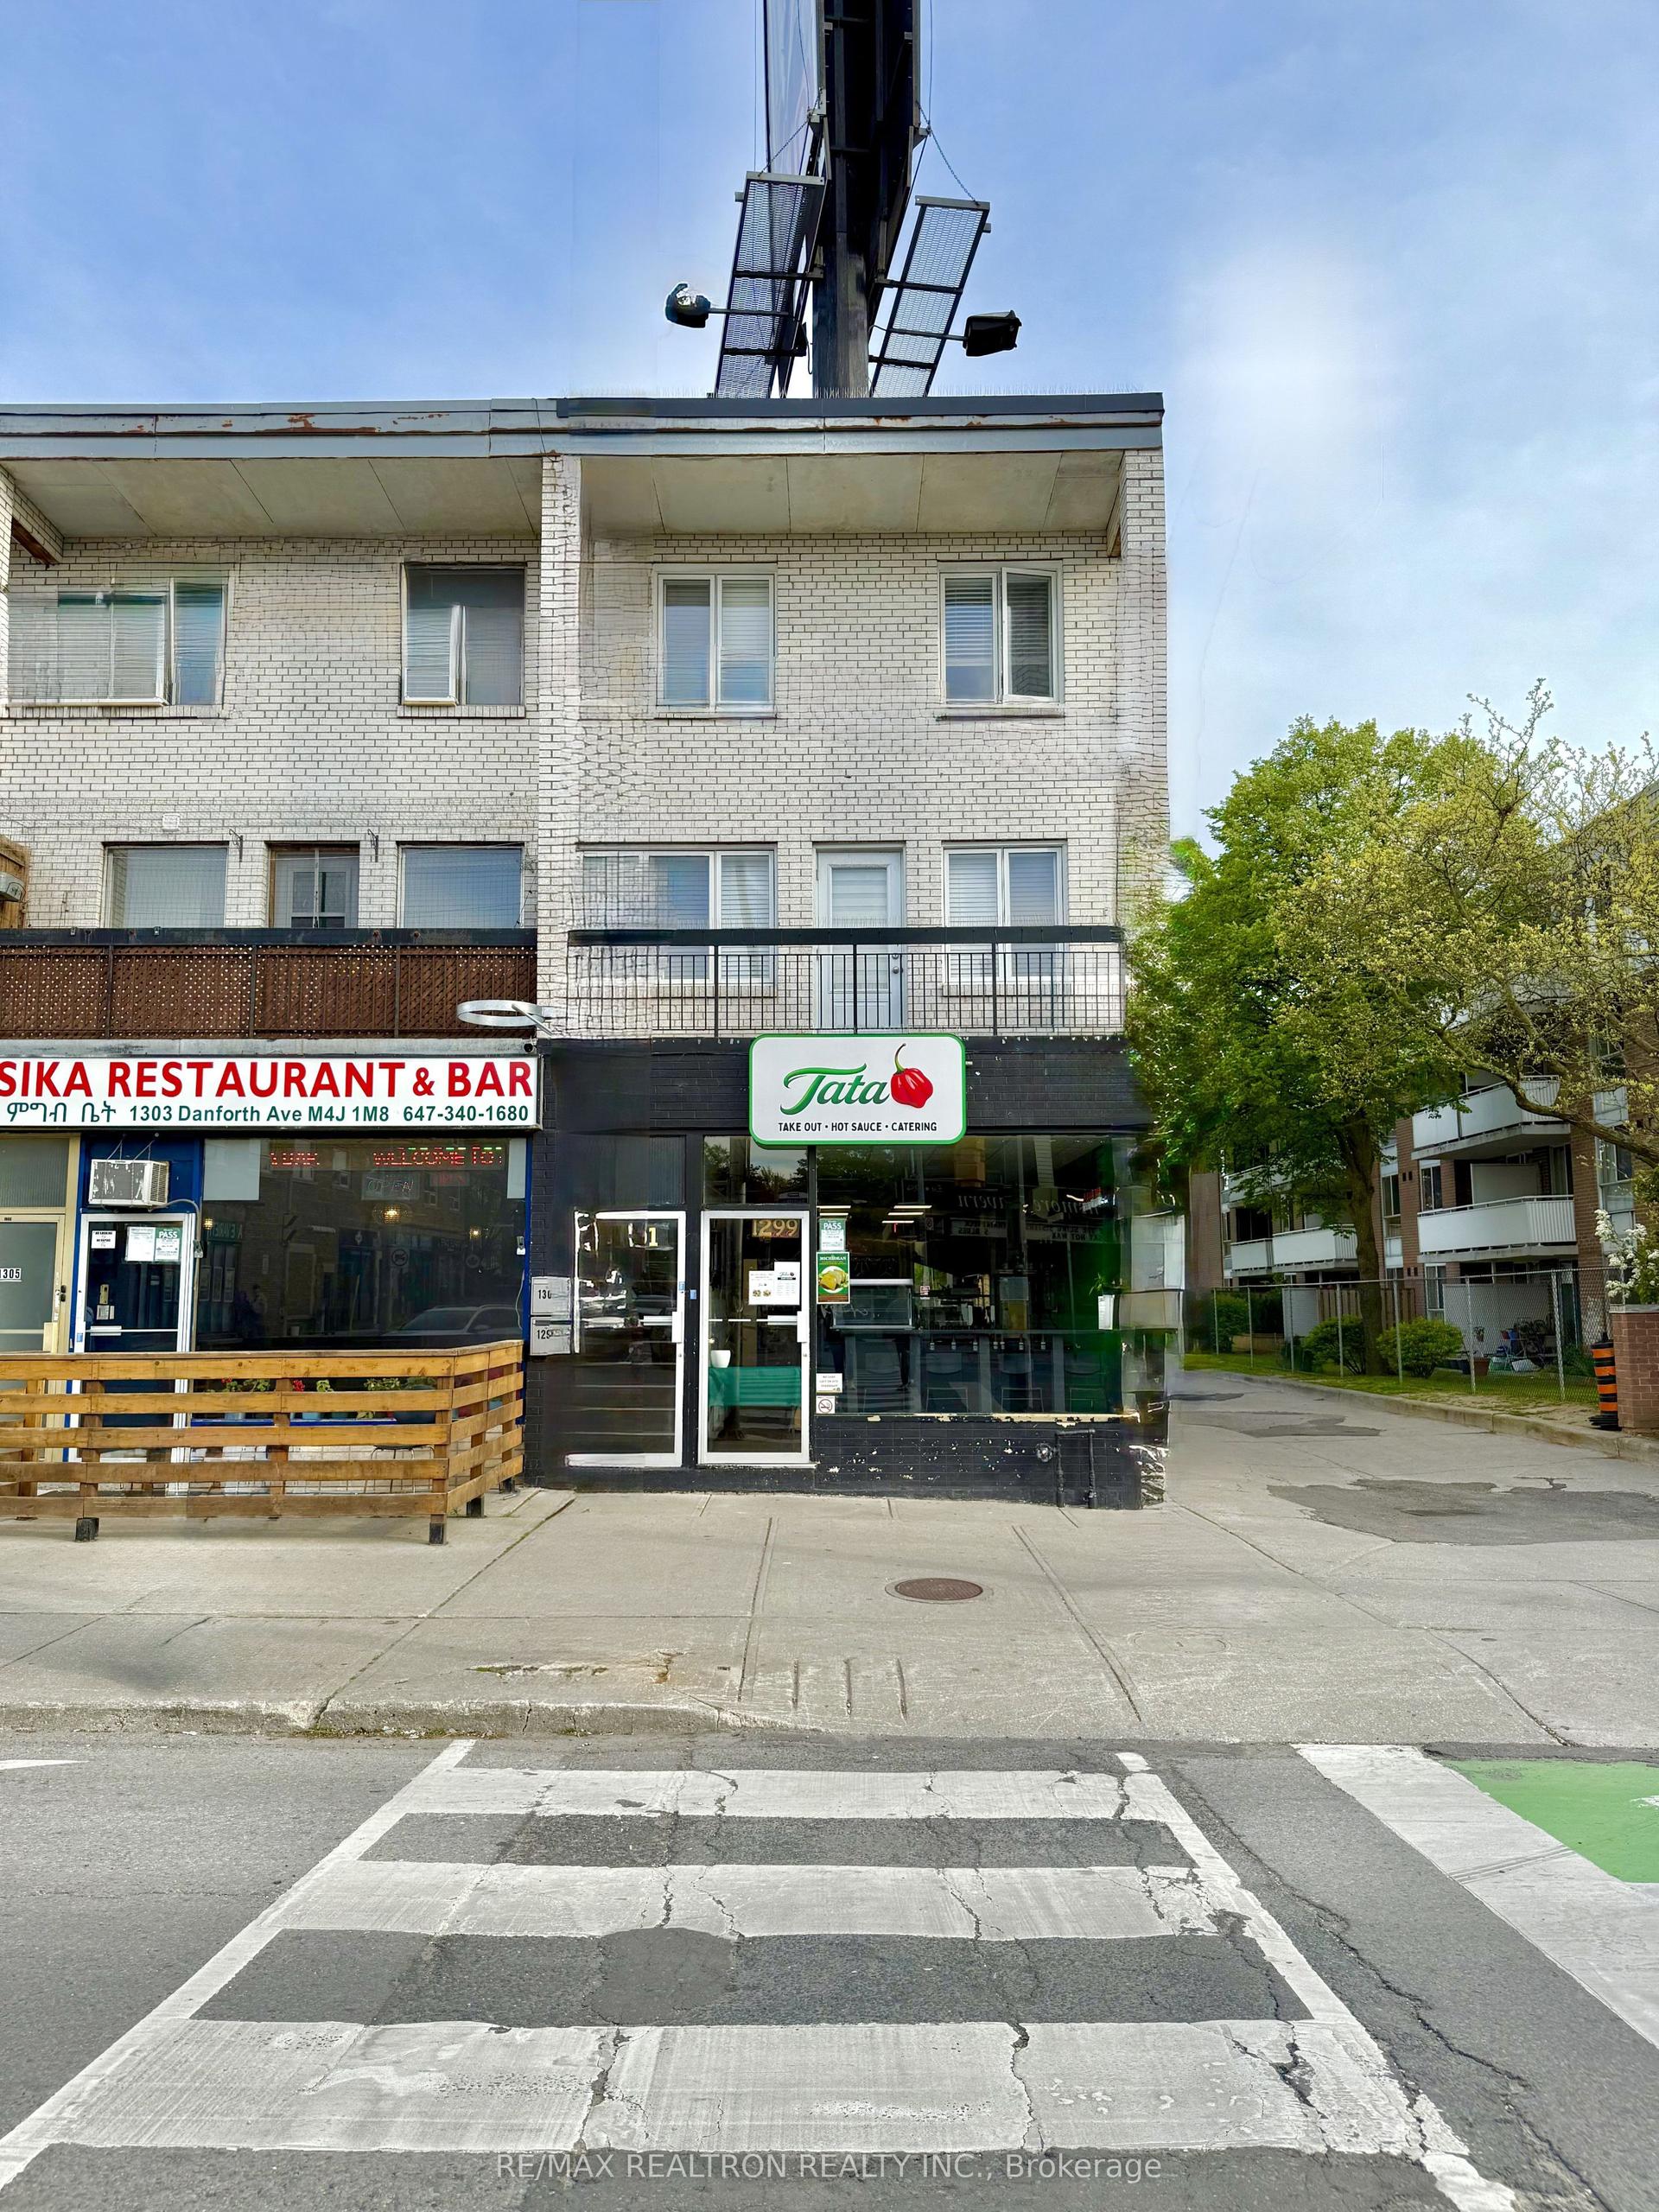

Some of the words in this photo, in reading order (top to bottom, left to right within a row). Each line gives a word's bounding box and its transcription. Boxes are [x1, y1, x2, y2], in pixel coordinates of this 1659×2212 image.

[0, 1061, 92, 1097] SIKA
[108, 1061, 405, 1097] RESTAURANT
[412, 1067, 435, 1096] &
[448, 1061, 533, 1097] BAR
[780, 1063, 890, 1116] Tata
[7, 1102, 67, 1122] ምግብ
[81, 1101, 117, 1122] ቤት
[130, 1105, 173, 1122] 1303
[179, 1105, 260, 1122] Danforth
[267, 1106, 302, 1122] Ave
[308, 1106, 346, 1122] M4J
[353, 1106, 390, 1122] 1M8
[403, 1105, 529, 1122] 647-340-1680
[779, 1122, 801, 1132] TAKE
[804, 1122, 823, 1132] OUT
[831, 1122, 849, 1132] HOT
[851, 1122, 882, 1132] SAUCE
[892, 1122, 938, 1132] CATERING
[752, 1218, 799, 1237] 1299
